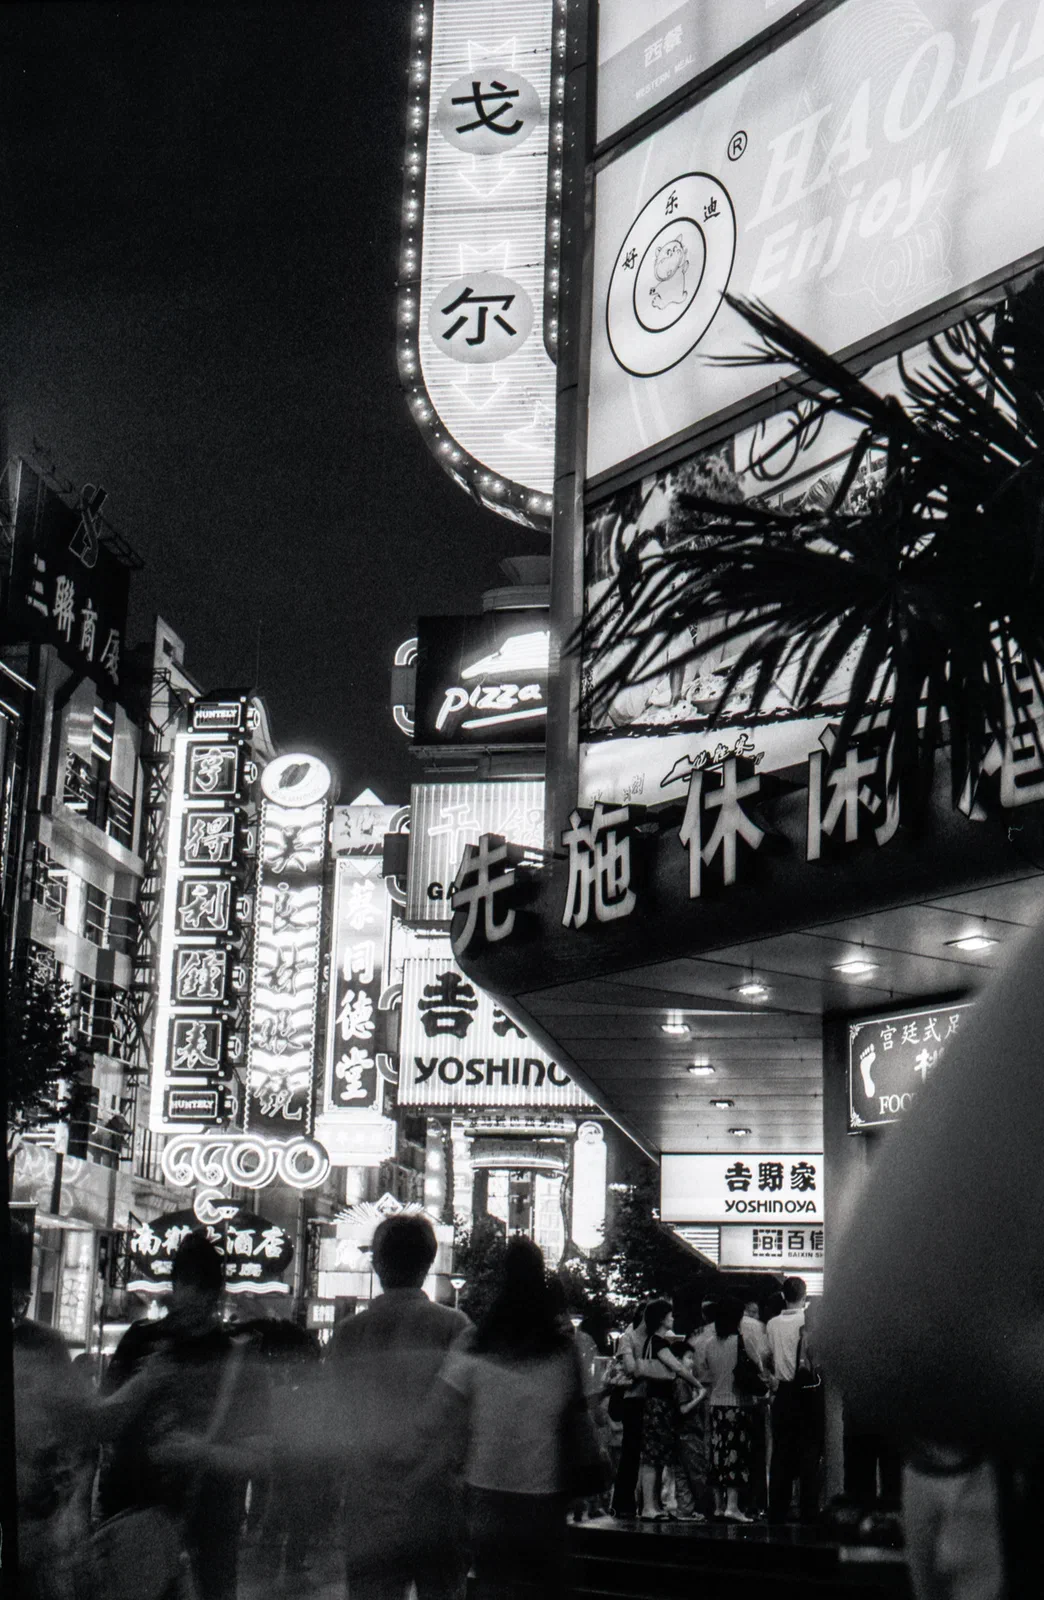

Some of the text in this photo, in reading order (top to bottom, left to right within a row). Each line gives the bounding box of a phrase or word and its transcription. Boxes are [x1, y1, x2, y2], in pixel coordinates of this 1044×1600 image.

[748, 148, 950, 297] Enjoy
[725, 1162, 816, 1192] 吉野家
[725, 1200, 816, 1214] YOSHINOYA
